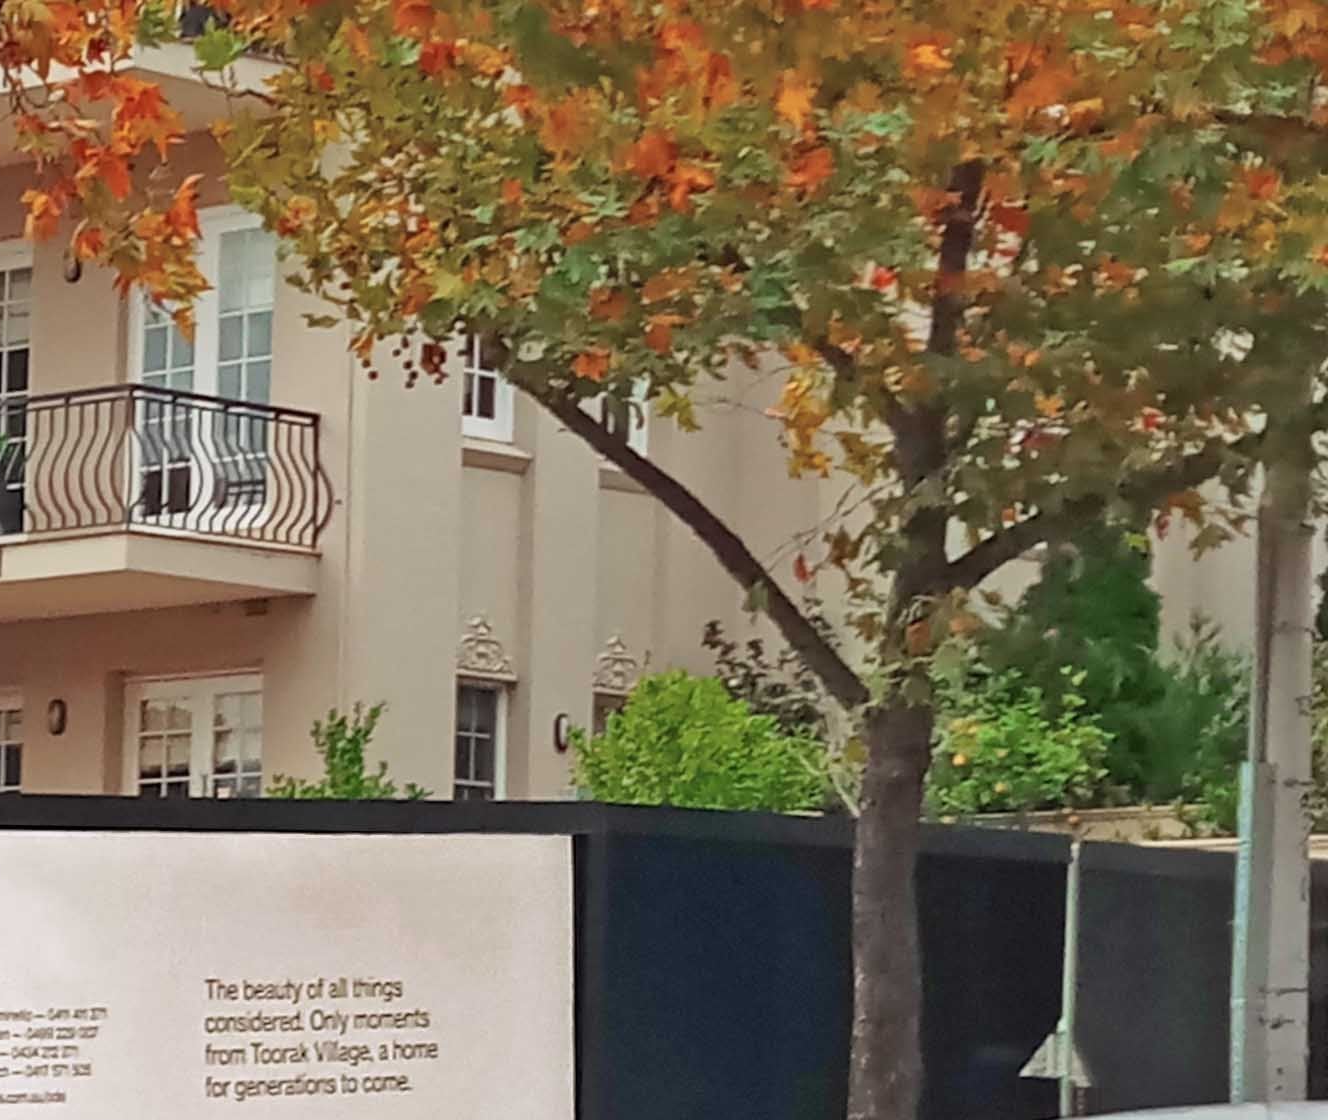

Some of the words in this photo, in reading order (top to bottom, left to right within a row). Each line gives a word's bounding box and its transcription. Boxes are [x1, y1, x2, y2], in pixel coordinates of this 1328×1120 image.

[206, 979, 239, 1000] The
[243, 980, 303, 1004] beauty
[307, 979, 324, 999] of
[329, 978, 349, 998] all
[353, 977, 403, 1002] things
[205, 1012, 304, 1033] considered.
[310, 1009, 350, 1035] Only
[354, 1010, 431, 1029] moments
[206, 1044, 246, 1064] from
[250, 1042, 310, 1064] Toorak
[379, 1047, 389, 1060] a
[392, 1041, 440, 1059] home
[206, 1076, 232, 1097] for
[235, 1075, 336, 1101] generations
[340, 1074, 359, 1093] to
[362, 1075, 412, 1091] come.
